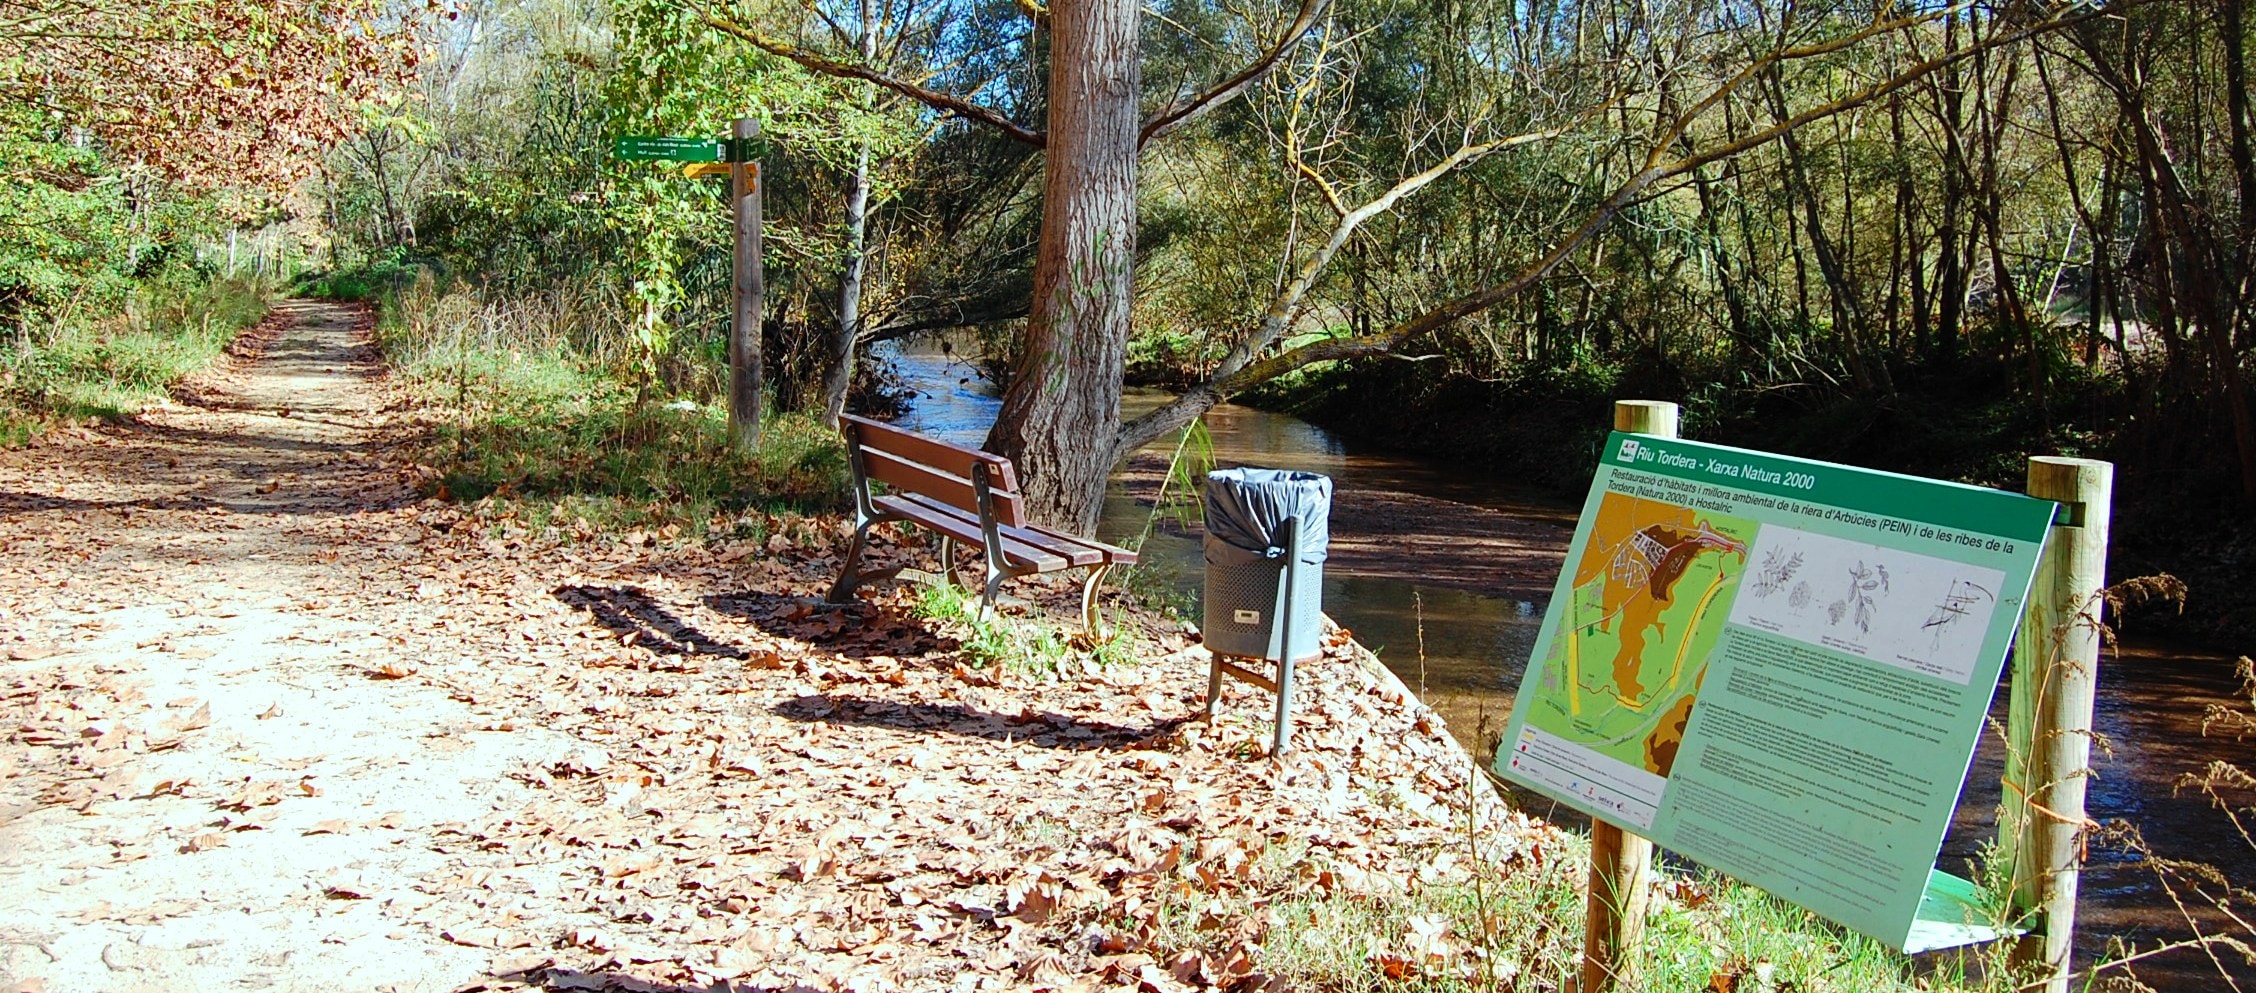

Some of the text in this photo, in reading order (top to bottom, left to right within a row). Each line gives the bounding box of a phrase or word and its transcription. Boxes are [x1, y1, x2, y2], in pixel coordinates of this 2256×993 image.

[1636, 446, 1655, 462] Riu
[1657, 449, 1697, 470] Tordera
[1705, 458, 1738, 477] Xarxa
[1740, 465, 1780, 484] Natura
[1783, 471, 1815, 490] 2000
[1607, 480, 1733, 514] Tordera (Natura 2000) a Hostalric
[1611, 468, 1656, 485] Restauració
[1703, 485, 1731, 500] millora
[1732, 491, 1775, 508] ambiental
[1777, 499, 1789, 511] de
[1791, 502, 1800, 514] la
[1801, 504, 1823, 518] riera
[1878, 518, 1912, 536] (PEIN)
[1919, 526, 1933, 539] de
[1936, 529, 1952, 542] les
[1954, 532, 1983, 548] ribes
[1985, 538, 2000, 551] de
[2002, 541, 2014, 554] la
